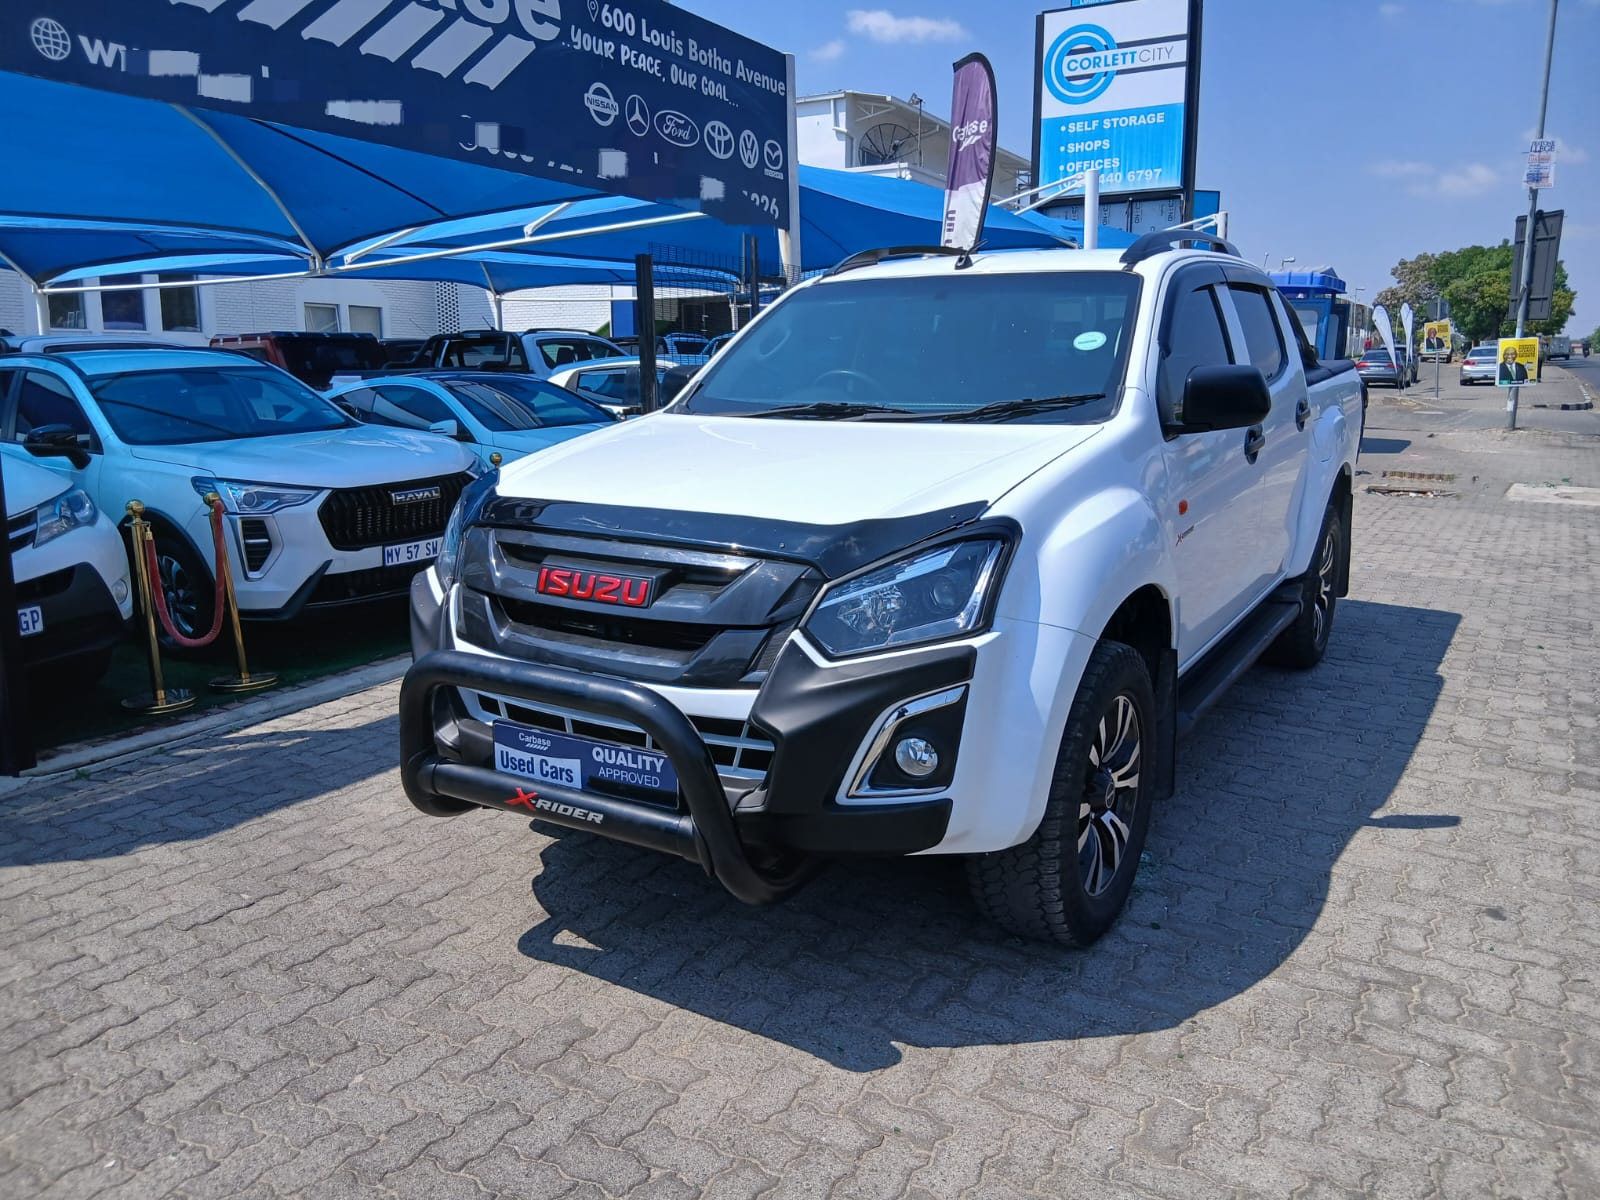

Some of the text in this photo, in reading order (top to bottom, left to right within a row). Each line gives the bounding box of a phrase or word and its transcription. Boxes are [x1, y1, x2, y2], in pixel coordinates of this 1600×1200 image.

[601, 3, 636, 36] 600
[642, 18, 684, 56] Louis
[689, 38, 732, 76] Botha
[735, 59, 786, 96] Avenue
[670, 64, 698, 91] OUR
[586, 96, 618, 112] NISSAN
[663, 115, 692, 141] Ford
[1067, 112, 1165, 133] SELF STORAGE
[1067, 139, 1110, 153] SHOPS
[1066, 157, 1120, 173] OFFICES
[1127, 168, 1162, 182] 6797
[395, 489, 440, 503] HAVAL
[406, 544, 420, 560] 57
[537, 566, 649, 606] ISUZU
[19, 609, 40, 633] GP
[518, 732, 551, 747] Carbase
[500, 750, 574, 784] Used Cars
[592, 746, 664, 773] QUALITY
[598, 766, 660, 788] APPROVED
[504, 786, 604, 825] X-RIDER
